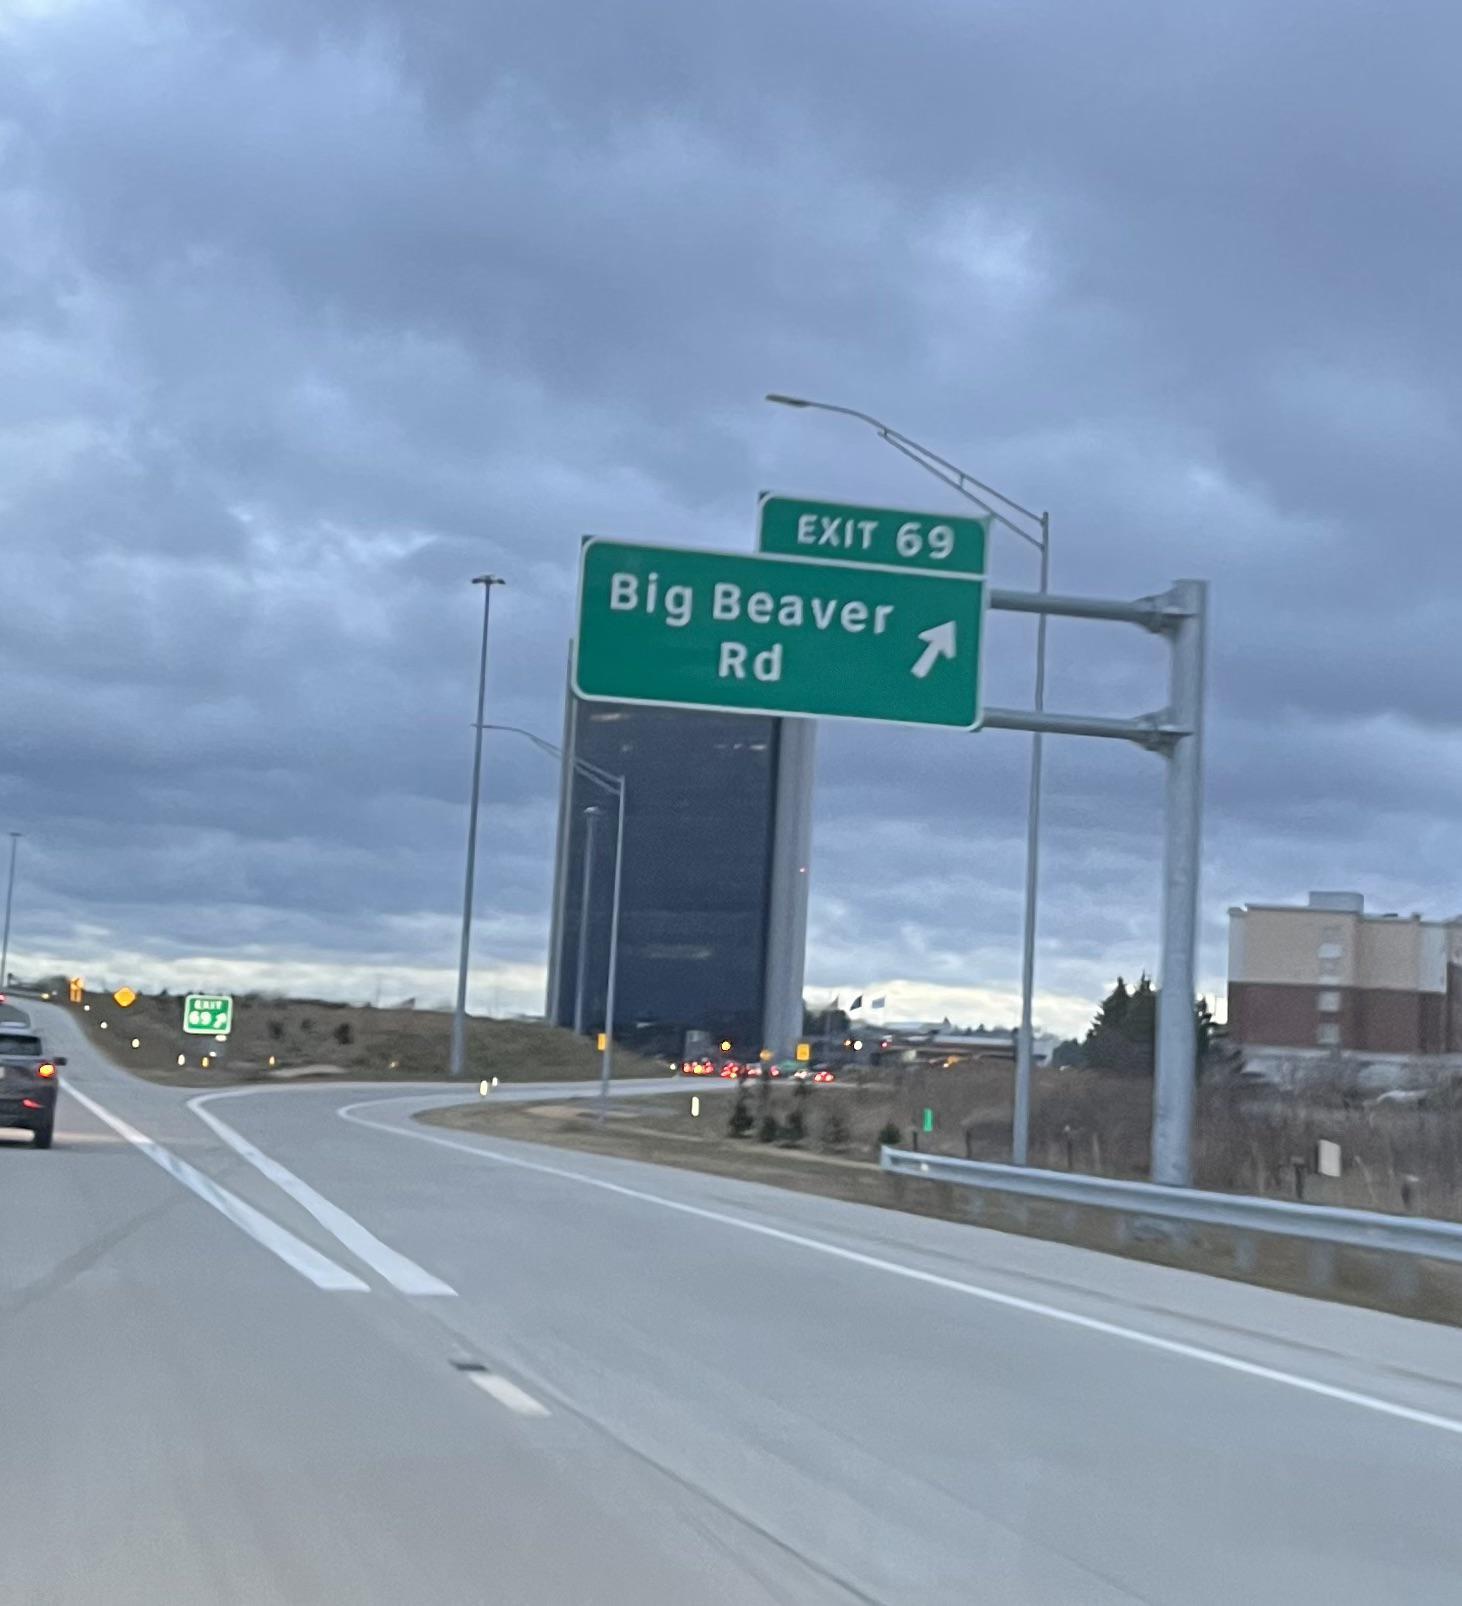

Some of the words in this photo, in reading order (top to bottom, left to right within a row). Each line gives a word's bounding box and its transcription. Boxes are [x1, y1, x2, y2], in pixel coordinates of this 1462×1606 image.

[797, 513, 879, 550] EXIT
[895, 521, 955, 559] 69
[609, 571, 694, 628] Big
[712, 582, 894, 635] Beaver
[718, 641, 784, 682] Rd
[189, 1011, 211, 1026] 69
[194, 999, 222, 1010] EXIT
